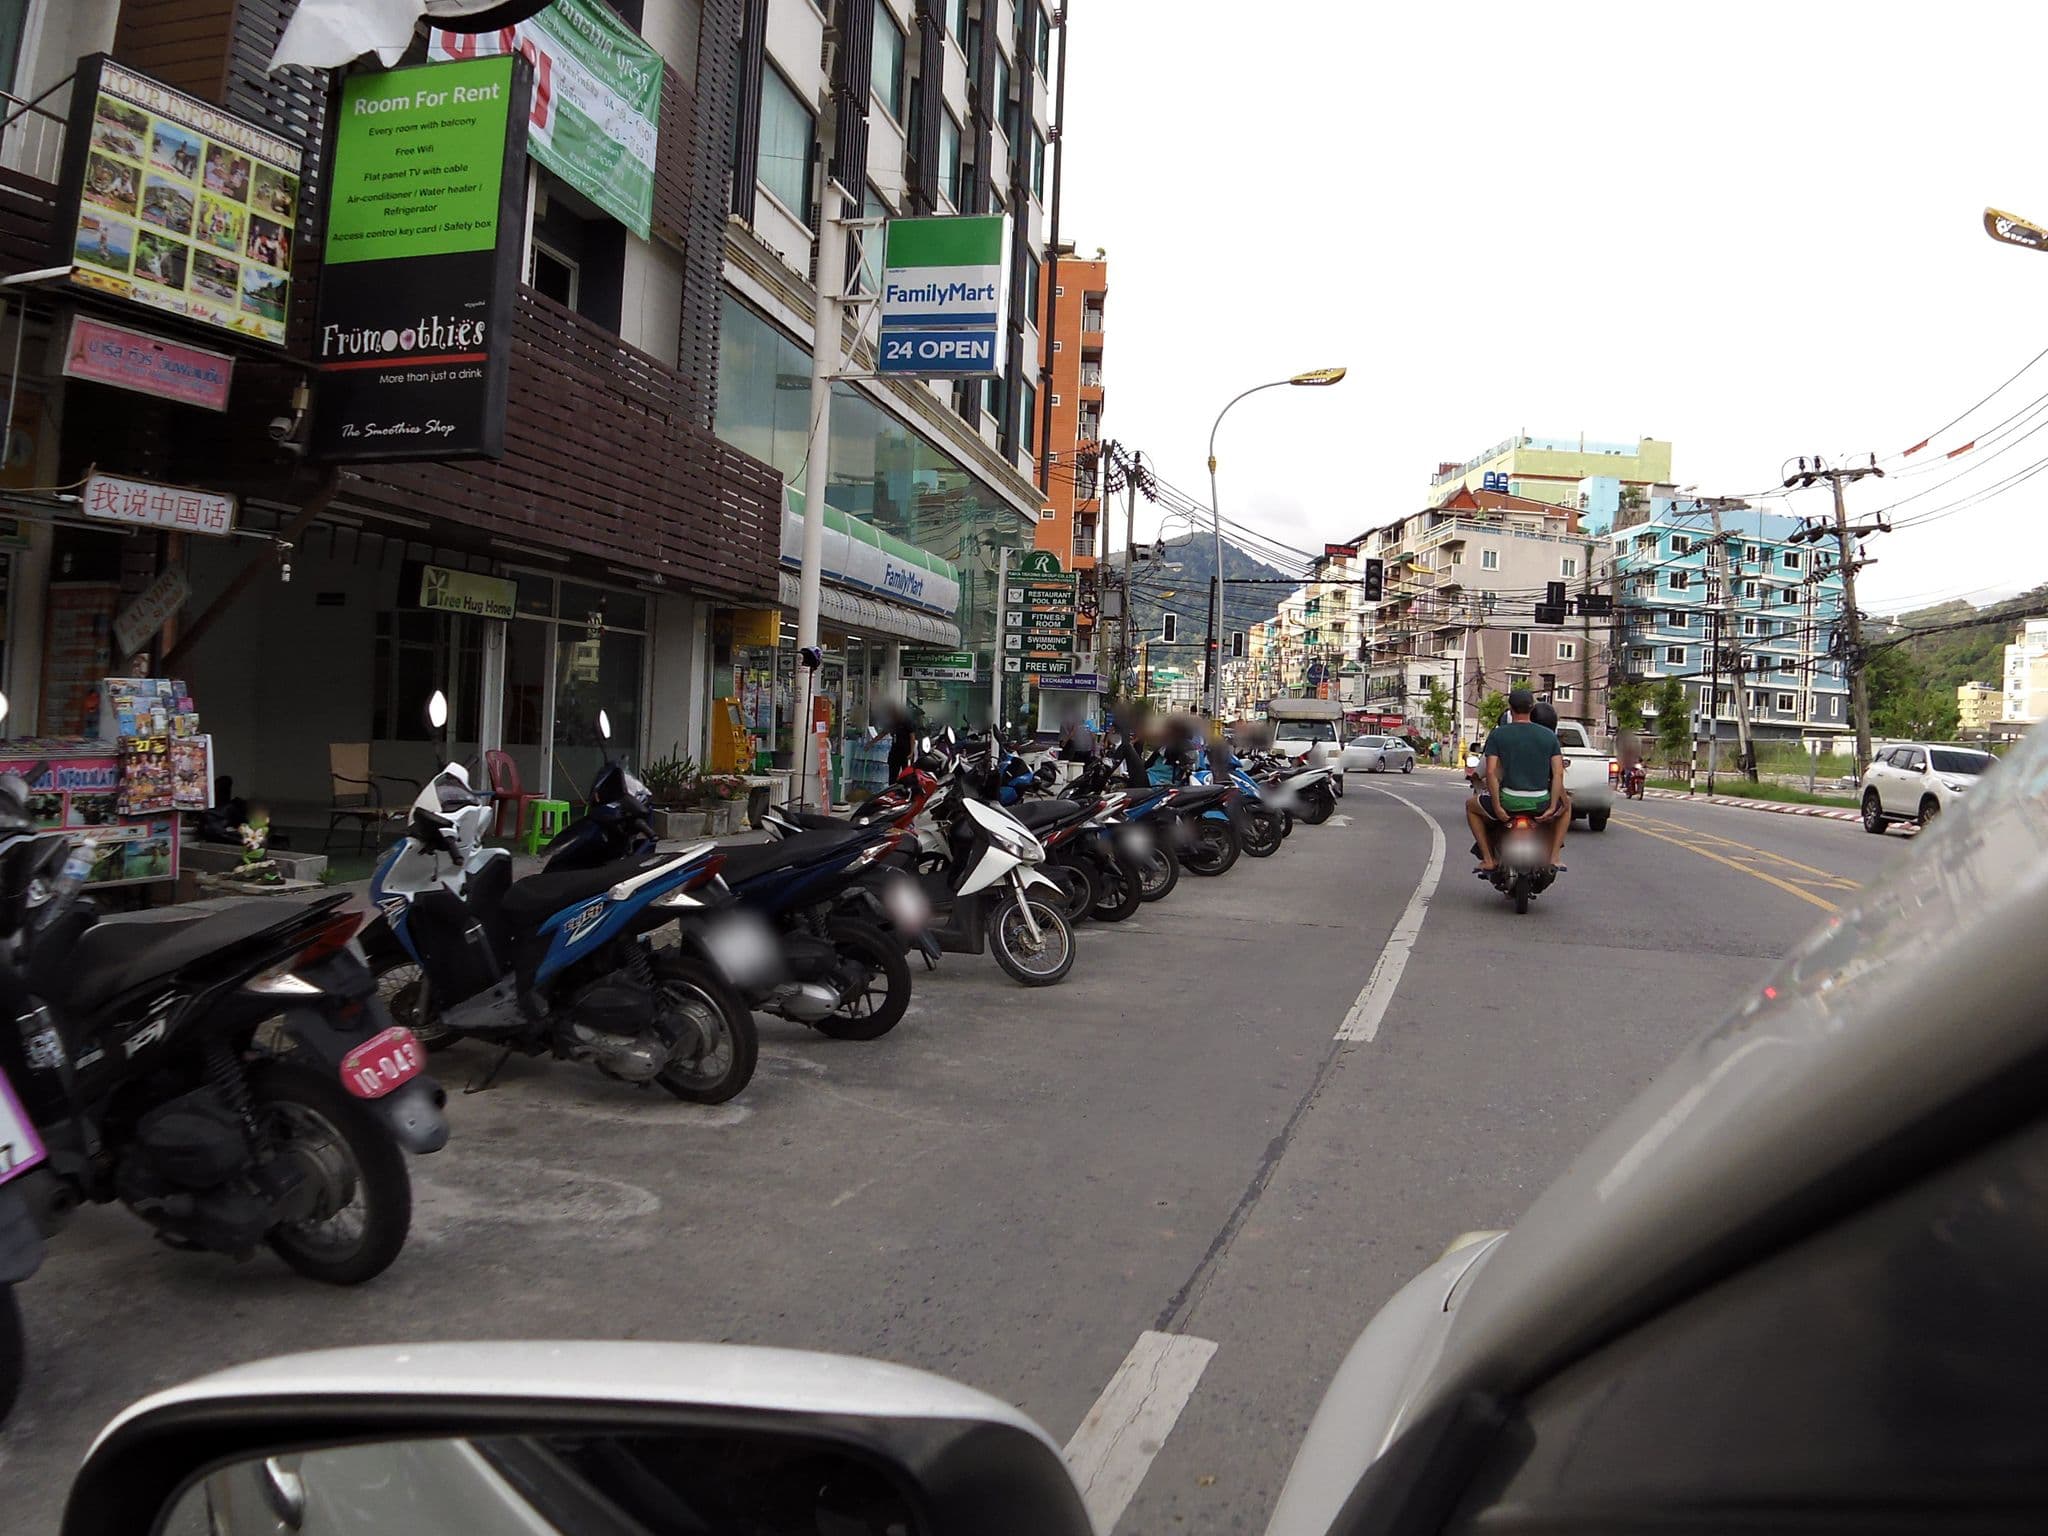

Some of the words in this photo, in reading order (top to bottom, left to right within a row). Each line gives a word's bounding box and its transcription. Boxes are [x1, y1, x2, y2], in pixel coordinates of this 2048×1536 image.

[354, 95, 409, 116] Room
[415, 90, 448, 108] For
[453, 82, 500, 104] Rent
[103, 67, 162, 108] TOUR
[166, 95, 299, 170] INFORMATION
[368, 126, 394, 137] Every
[395, 124, 418, 133] room
[420, 119, 439, 130] with
[440, 116, 476, 128] balcony
[395, 146, 415, 157] Free
[417, 144, 434, 154] Wifi
[364, 172, 380, 182] Flat
[381, 169, 407, 183] panel
[409, 167, 421, 177] TV
[422, 165, 442, 176] with
[443, 163, 469, 174] cable
[347, 189, 412, 204] Air-conditioner
[419, 187, 446, 197] Water
[447, 184, 476, 194] heater
[383, 204, 438, 217] Refrigerator
[332, 231, 364, 242] Access
[366, 227, 397, 239] control
[399, 226, 416, 238] key
[416, 224, 437, 235] card
[443, 221, 472, 233] Safety
[474, 218, 492, 229] box
[886, 282, 995, 306] FamilyMart
[886, 341, 913, 359] 24
[918, 340, 990, 359] OPEN
[379, 374, 405, 384] More
[407, 372, 429, 382] than
[430, 370, 447, 383] just
[449, 372, 457, 380] a
[459, 368, 483, 379] drink
[342, 424, 360, 438] The
[364, 422, 422, 438] Smoothies
[425, 419, 456, 437] Shop
[92, 482, 226, 528] 我说中国话
[883, 563, 924, 597] FamilyMart
[440, 591, 461, 608] Tree
[463, 595, 483, 613] Hug
[485, 600, 512, 616] Home
[1028, 591, 1072, 599] RESTAURANT
[1031, 613, 1066, 621] FITNESS
[1027, 636, 1067, 644] SWIMMING
[916, 653, 954, 662] FamilyMart
[1025, 662, 1047, 672] FREE
[1049, 662, 1067, 673] WIFI
[1075, 677, 1097, 685] MONEY
